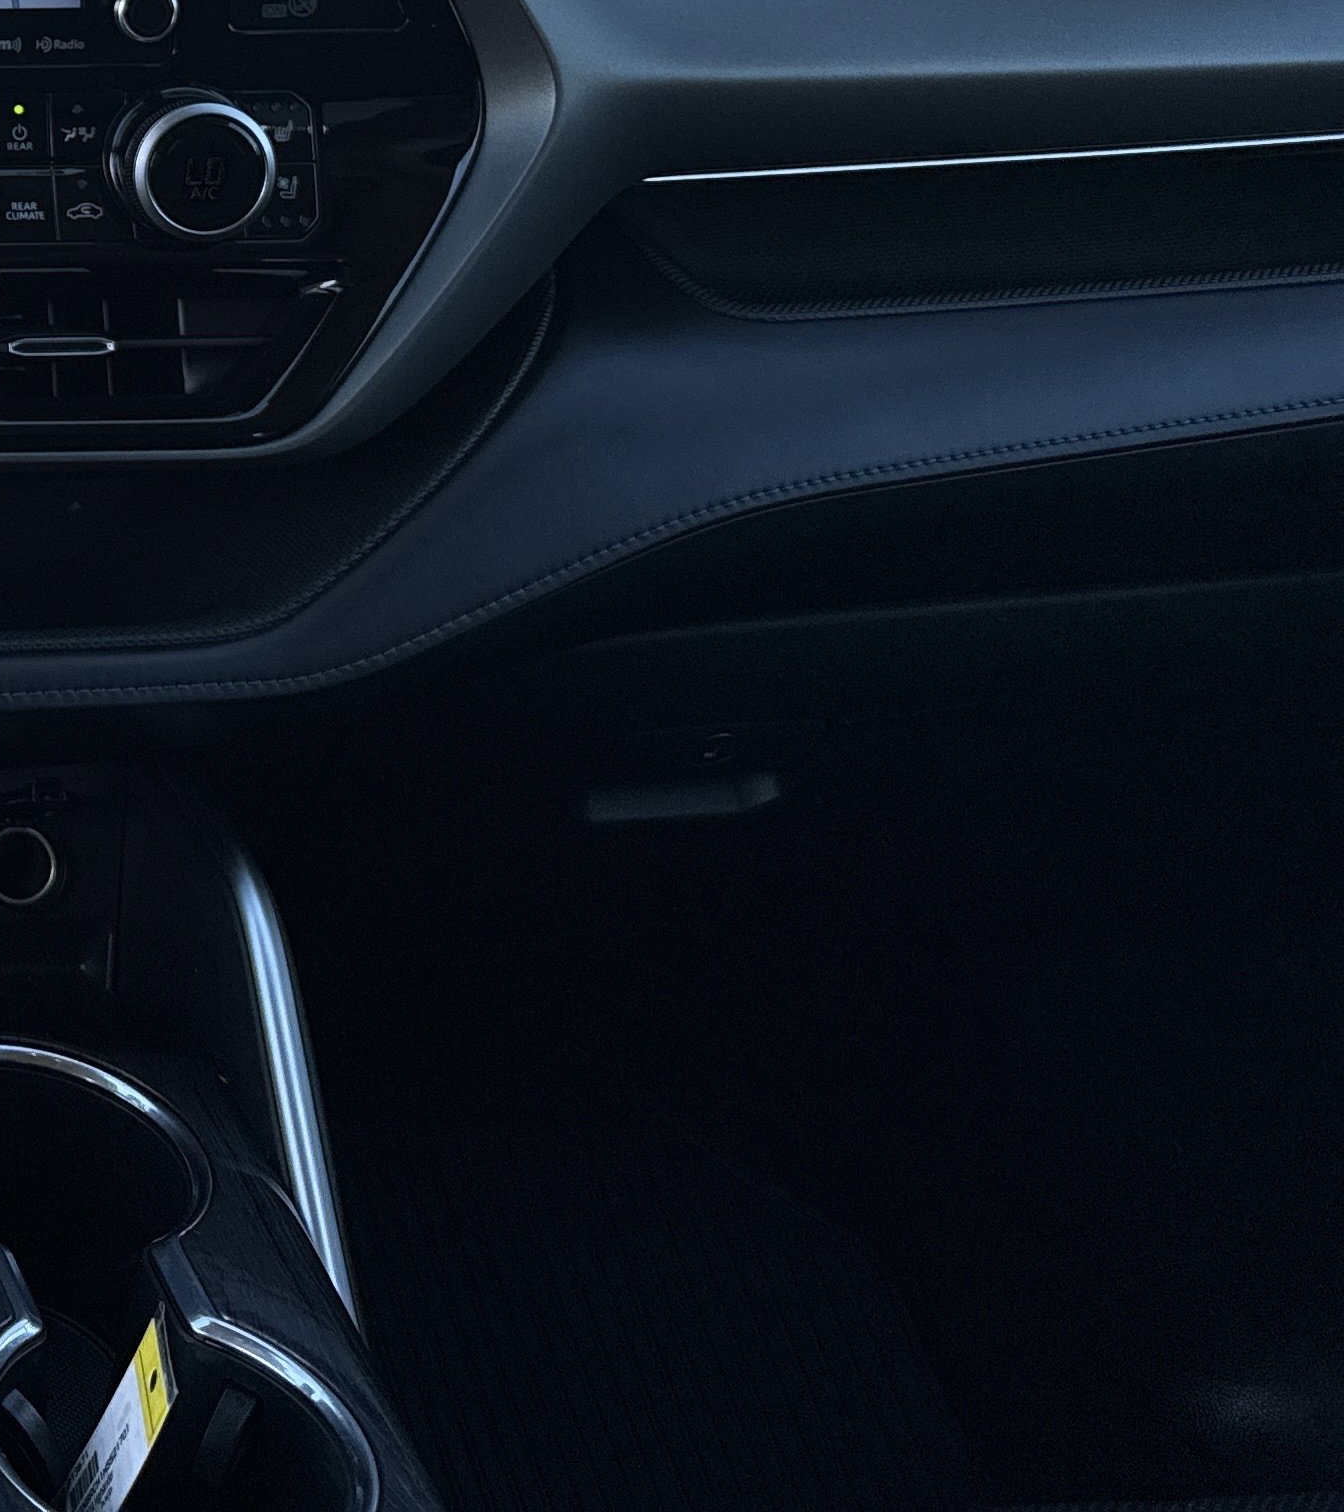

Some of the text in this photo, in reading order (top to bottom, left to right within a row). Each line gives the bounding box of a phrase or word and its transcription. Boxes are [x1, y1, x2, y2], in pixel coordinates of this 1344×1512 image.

[7, 142, 33, 151] REAR
[11, 202, 38, 211] REAR
[5, 210, 46, 222] CLIMATE
